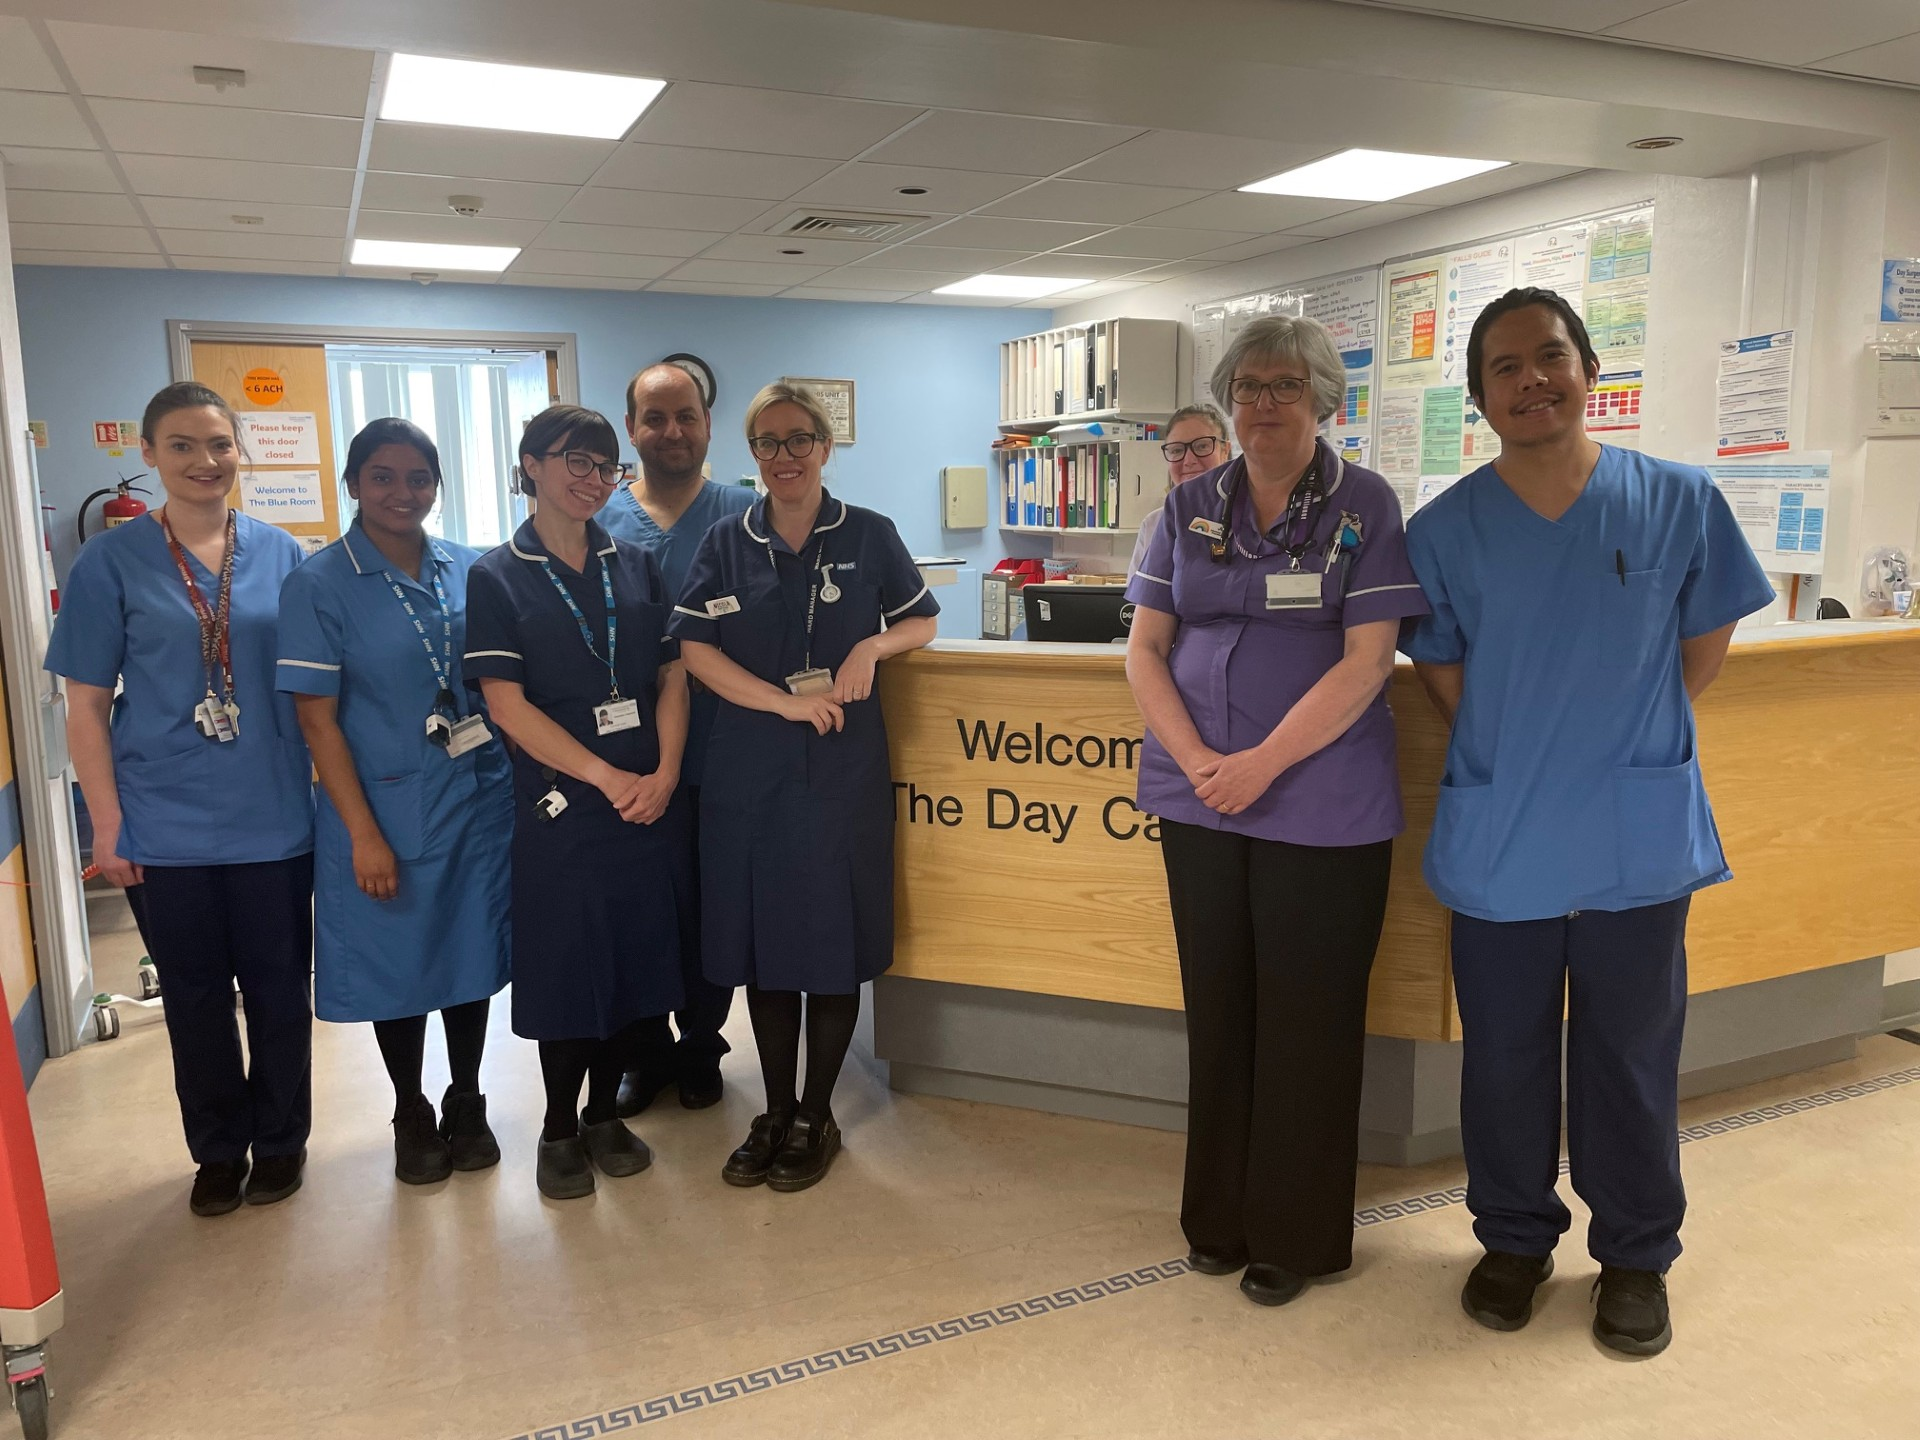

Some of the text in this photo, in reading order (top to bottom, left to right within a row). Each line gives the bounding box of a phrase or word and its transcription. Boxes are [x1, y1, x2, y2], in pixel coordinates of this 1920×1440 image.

[281, 424, 304, 434] keep
[255, 486, 296, 495] Welcome
[838, 562, 856, 570] NHS
[555, 583, 567, 595] NHS
[565, 598, 576, 610] NHS
[809, 584, 817, 613] MANAGER
[392, 585, 405, 599] NHS
[402, 602, 416, 616] NHS
[412, 619, 425, 634] NHS
[422, 638, 434, 653] NHS
[430, 656, 441, 672] NHS
[956, 719, 1143, 769] Welcom
[891, 781, 1162, 844] The Day Ca
